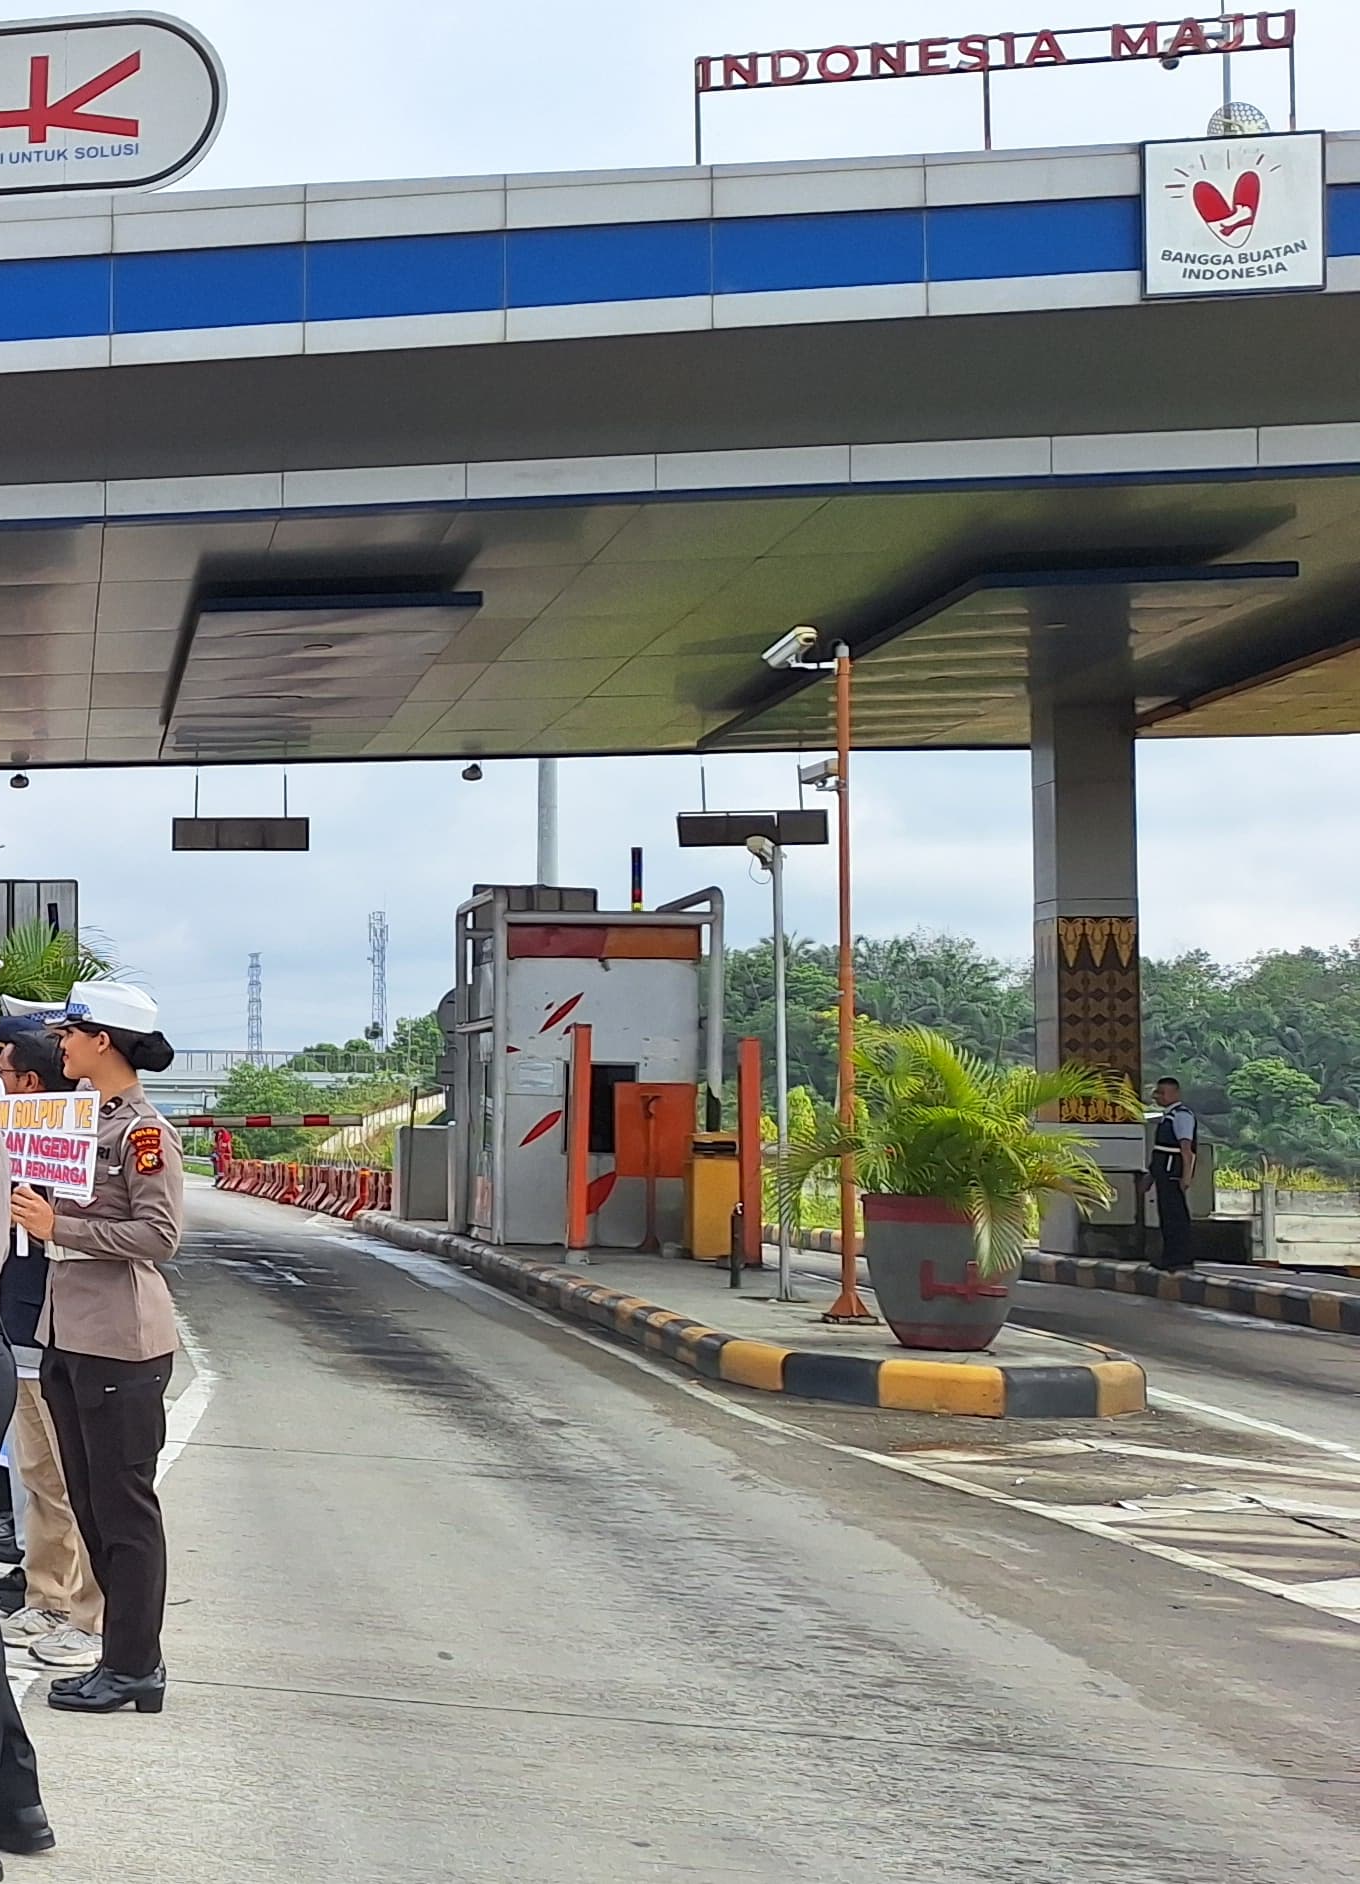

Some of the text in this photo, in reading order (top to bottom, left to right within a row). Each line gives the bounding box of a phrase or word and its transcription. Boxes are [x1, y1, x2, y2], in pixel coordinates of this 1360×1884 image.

[696, 9, 1295, 90] INDONESIA MAJU
[9, 149, 68, 164] UNTUK
[74, 143, 139, 160] SOLUSI
[1161, 240, 1308, 265] BANGGA BUATAN
[1182, 262, 1288, 280] INDONESIA
[13, 1099, 67, 1129] GOLPUT
[131, 1128, 158, 1140] POLDA
[29, 1134, 90, 1162] NGEBUT
[25, 1158, 88, 1186] BERHARGA
